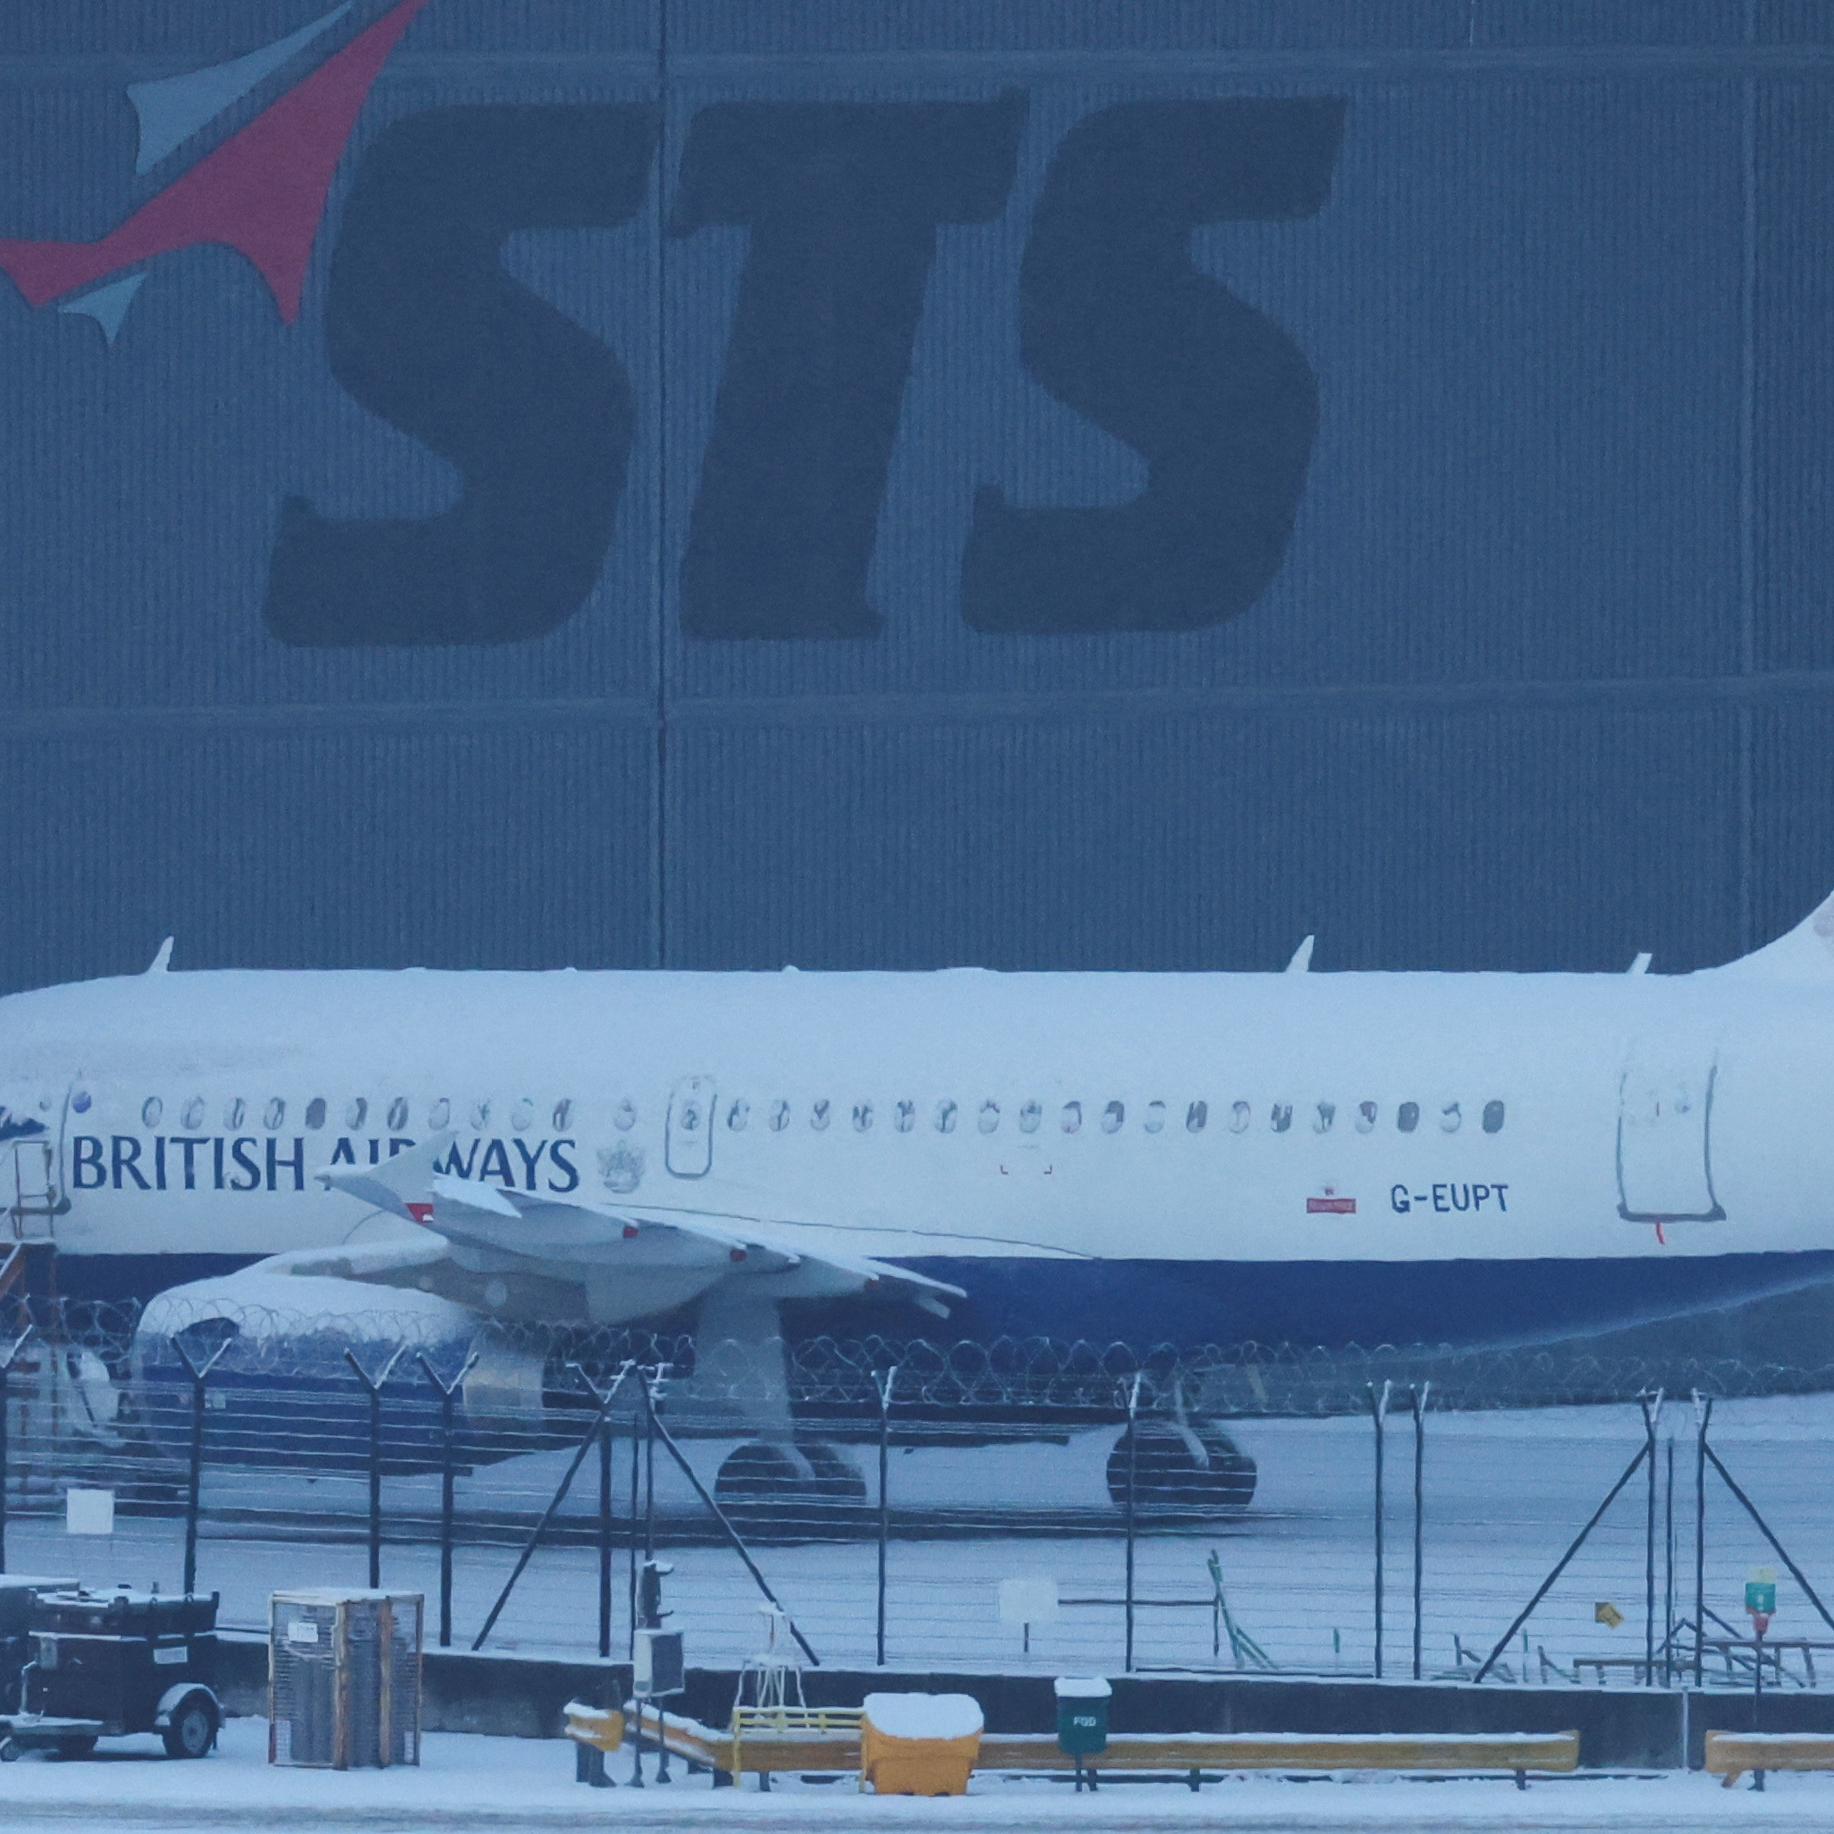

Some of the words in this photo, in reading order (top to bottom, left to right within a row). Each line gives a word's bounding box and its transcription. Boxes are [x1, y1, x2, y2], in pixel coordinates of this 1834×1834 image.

[262, 86, 1351, 646] STS
[72, 1135, 304, 1192] BRITISH
[1391, 1183, 1509, 1214] G-EUPT
